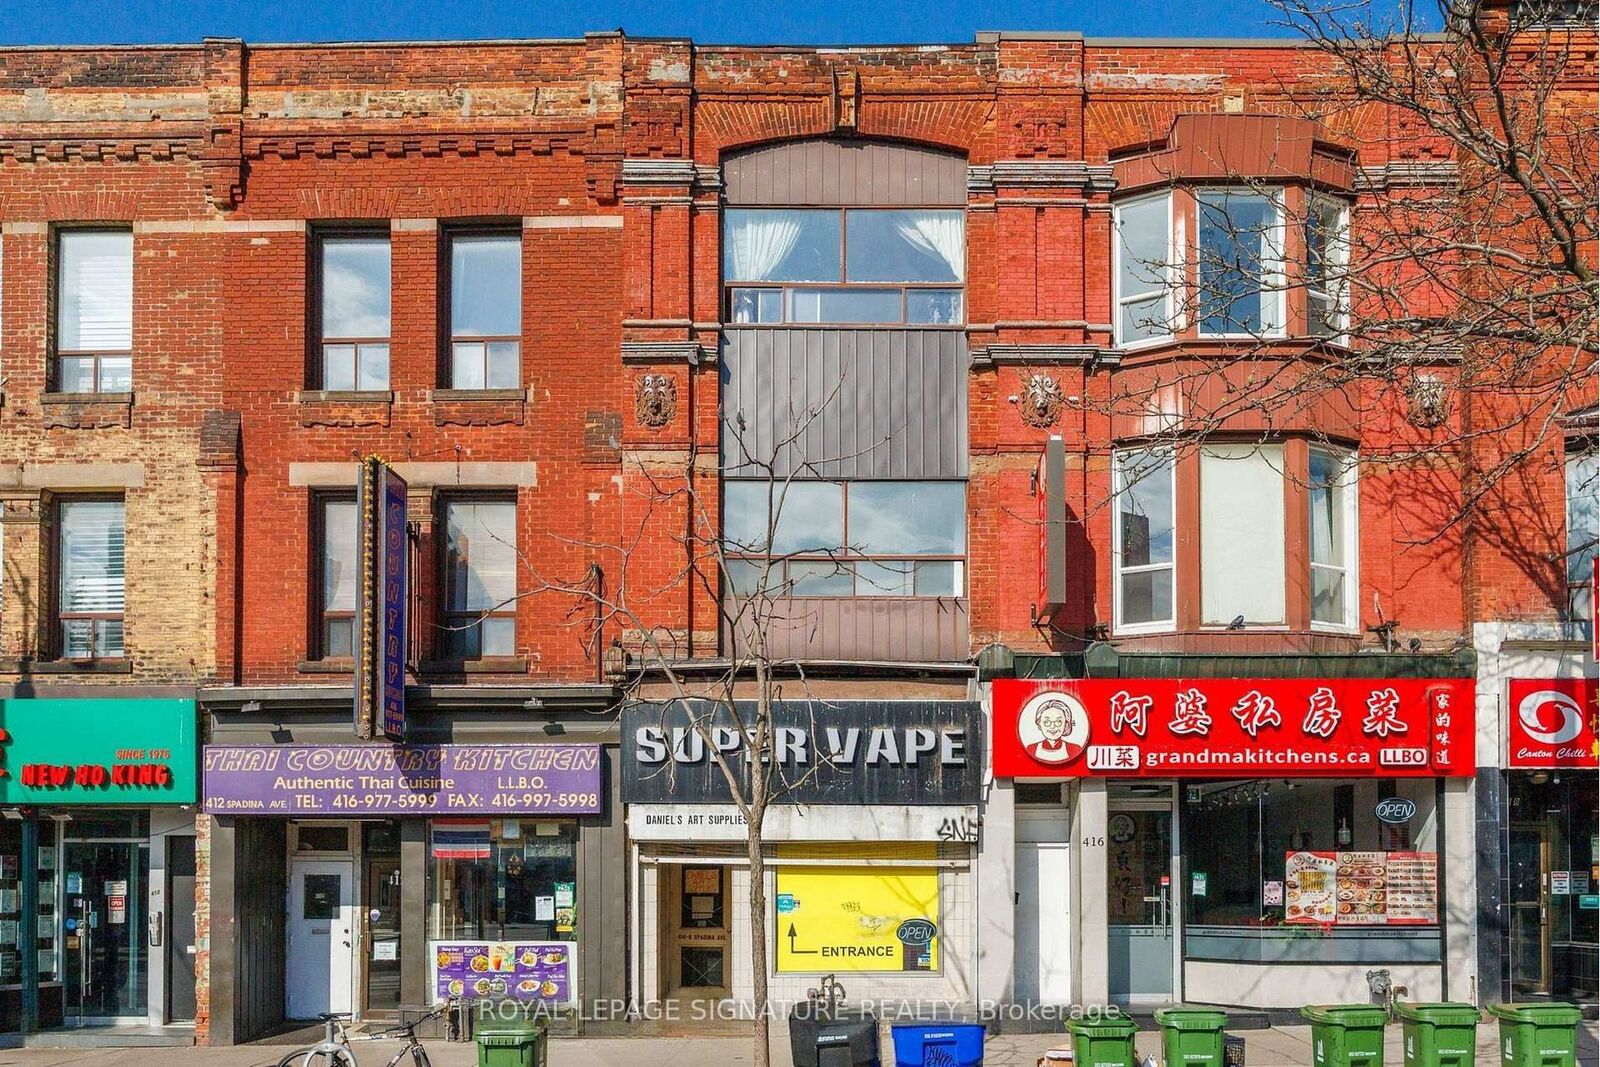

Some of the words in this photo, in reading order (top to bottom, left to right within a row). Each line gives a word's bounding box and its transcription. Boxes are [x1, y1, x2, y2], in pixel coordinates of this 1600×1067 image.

[1110, 687, 1408, 737] 阿婆私房菜
[1435, 693, 1450, 765] 家的味道
[636, 727, 806, 763] SUPER
[826, 727, 965, 764] VAPE
[116, 750, 144, 759] SINCE
[205, 749, 281, 771] THAI
[287, 749, 448, 771] COUNTRY
[454, 749, 598, 771] KITCHEN
[1091, 748, 1134, 767] 川菜
[1146, 749, 1370, 766] grandmakitchens.ca
[1383, 750, 1425, 763] LLBO
[1517, 747, 1553, 759] Canton
[1556, 747, 1586, 759] Chilli
[21, 764, 70, 786] NEW
[75, 764, 105, 786] HO
[111, 763, 170, 786] KING
[273, 776, 354, 789] Authentic
[359, 776, 394, 789] Thai
[399, 776, 455, 789] Cuisine
[497, 776, 548, 789] L.L.B.O.
[206, 797, 225, 808] 412
[227, 800, 264, 809] SPADINA
[269, 800, 288, 809] AVE.
[295, 794, 323, 808] TEL:
[332, 793, 437, 808] 416-977-5999
[448, 794, 484, 808] FAX:
[491, 793, 598, 808] 416-997-5998
[1378, 804, 1412, 817] OPEN
[688, 815, 703, 825] ART
[1082, 836, 1104, 847] 416
[899, 926, 932, 940] OPEN
[822, 946, 894, 957] ENTRANCE
